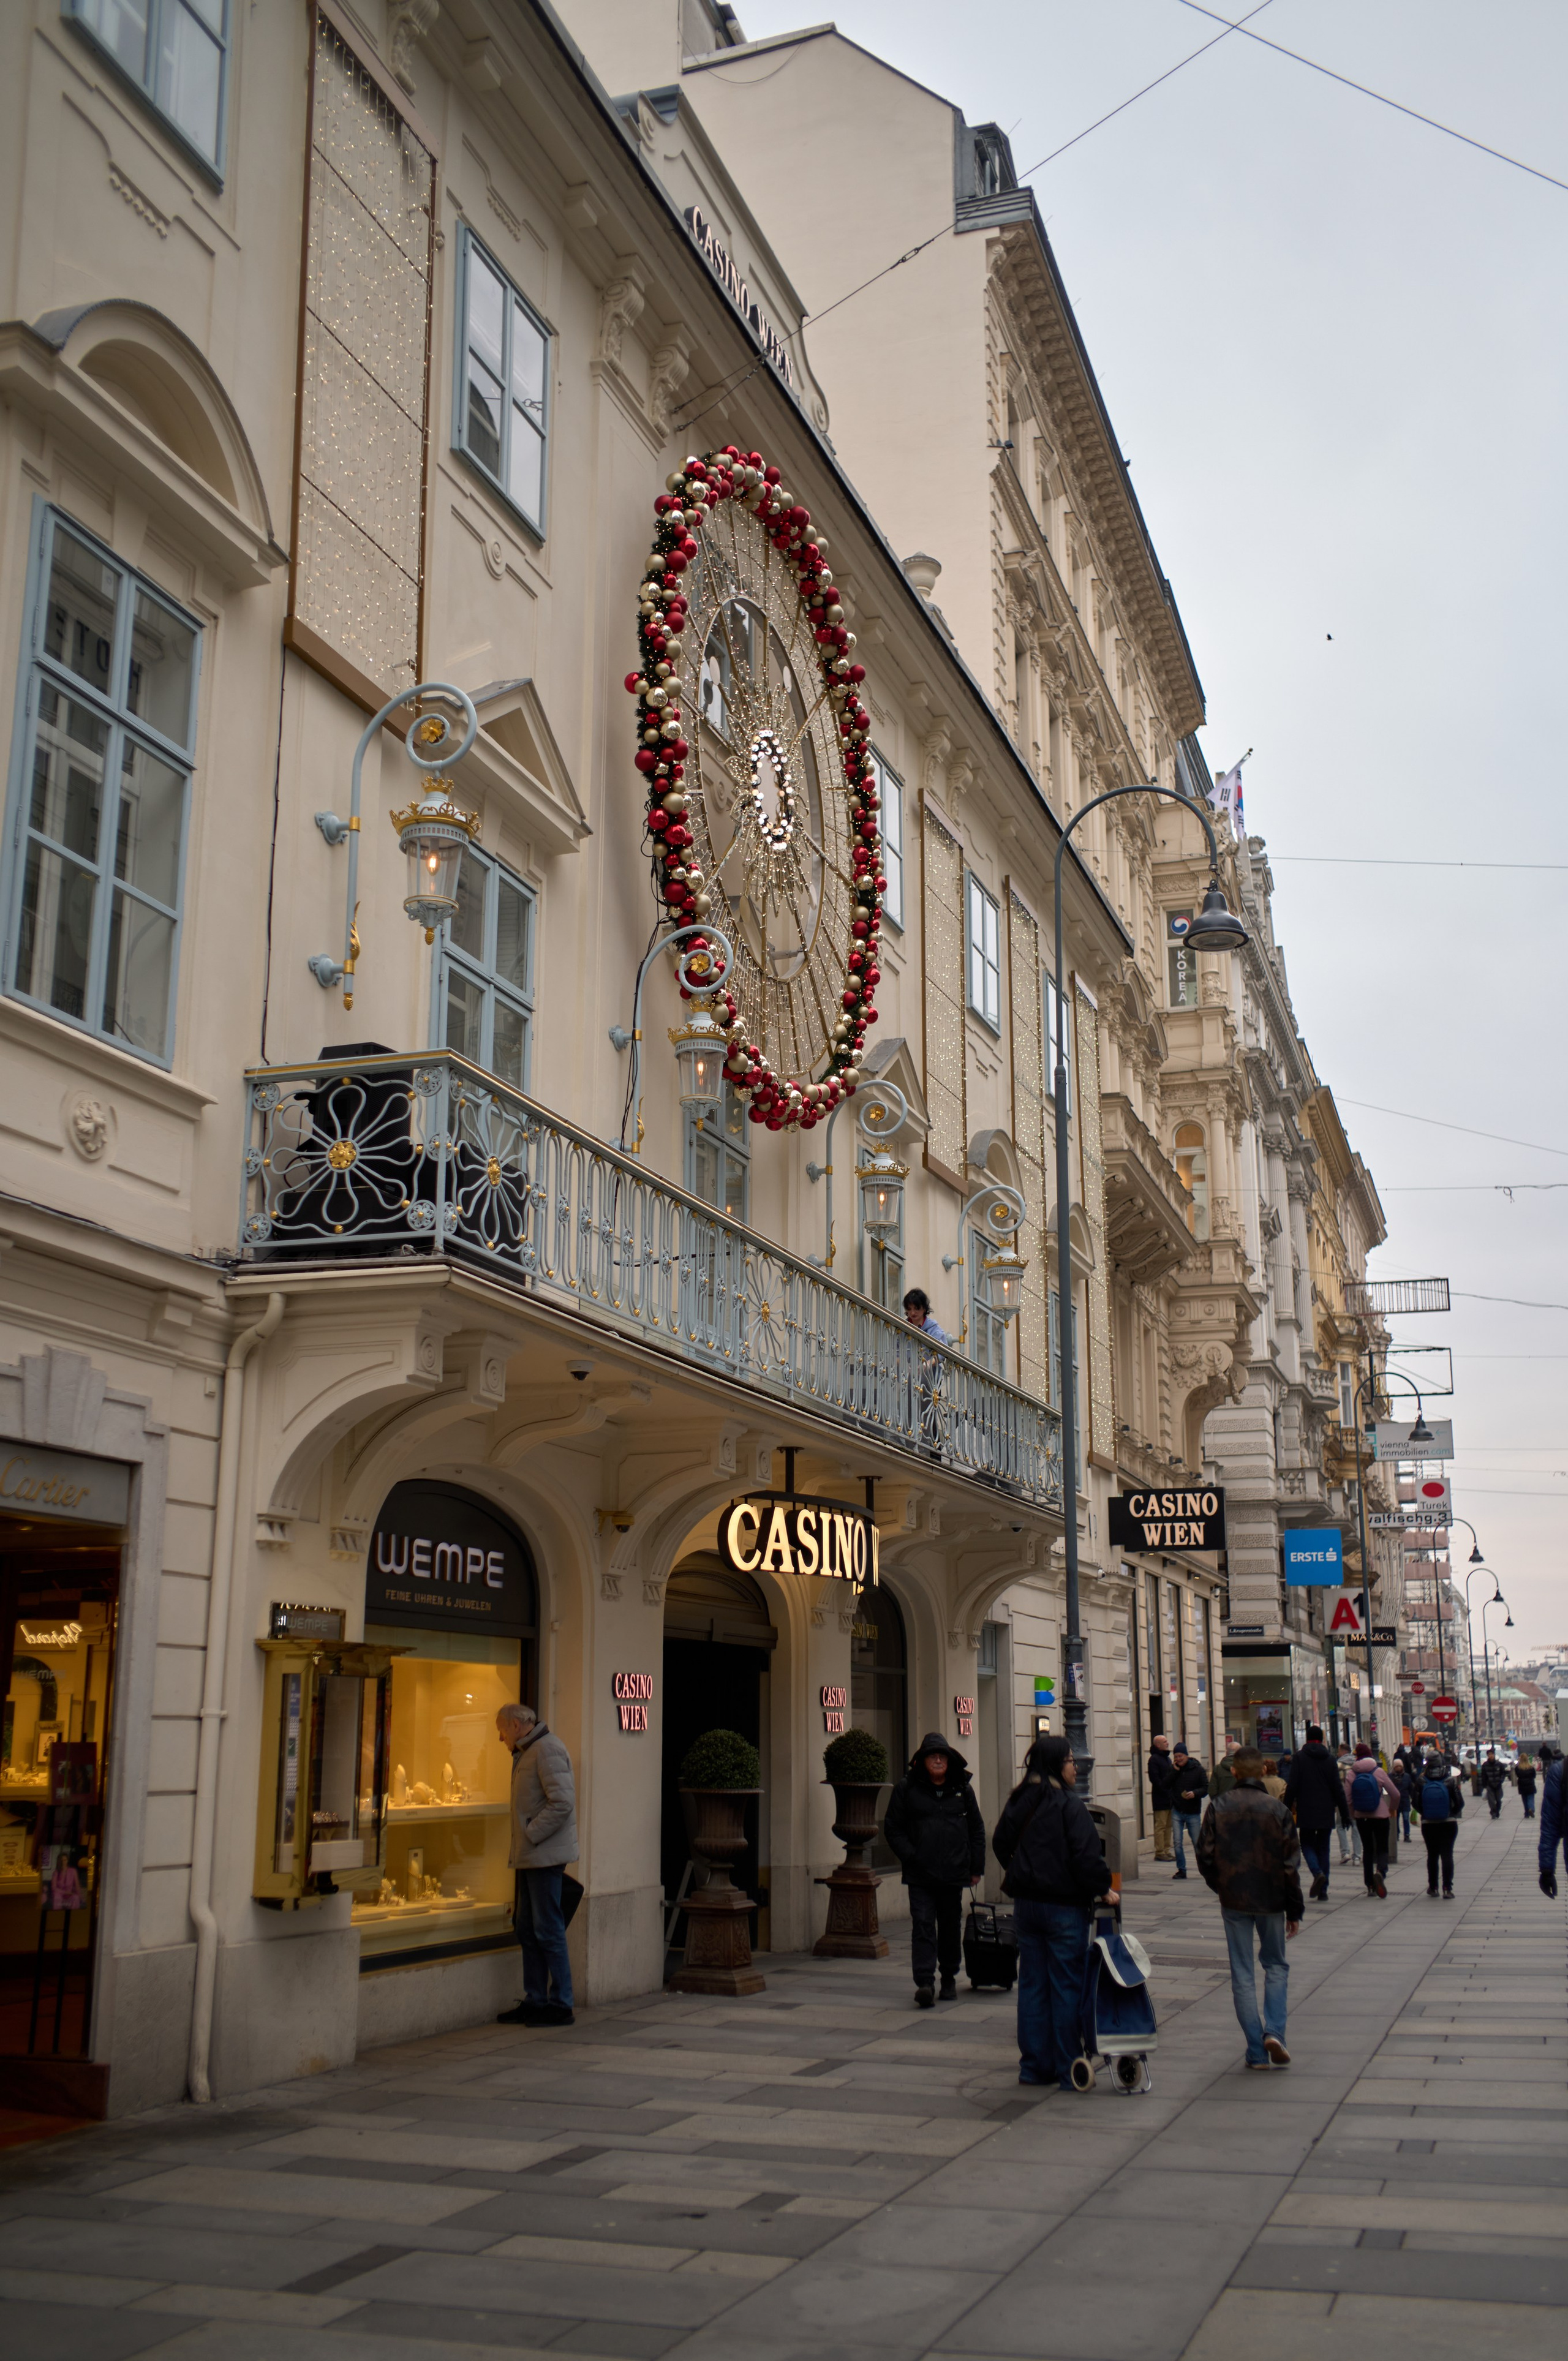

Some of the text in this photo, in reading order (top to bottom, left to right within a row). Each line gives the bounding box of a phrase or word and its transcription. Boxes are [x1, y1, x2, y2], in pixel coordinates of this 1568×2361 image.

[692, 205, 793, 388] CASINO WIEN
[1177, 950, 1187, 1002] KOREA
[1380, 1448, 1450, 1457] immobilien.com
[0, 1456, 90, 1507] Cartier
[1129, 1493, 1218, 1518] CASINO
[1420, 1501, 1448, 1510] Turek
[727, 1503, 867, 1582] CASINO
[1141, 1522, 1205, 1546] WIEN
[377, 1531, 505, 1589] WEMPE
[1291, 1552, 1324, 1562] ERSTE
[385, 1589, 491, 1611] FEINE UHREN & JUWELEN
[1330, 1593, 1365, 1630] A1
[287, 1617, 328, 1632] WEMPE
[615, 1673, 652, 1699] CASINO
[823, 1686, 846, 1707] CASINO
[956, 1696, 974, 1714] CASINO
[620, 1705, 647, 1730] WIEN
[826, 1712, 843, 1732] WIEN
[959, 1718, 973, 1735] WIEN
